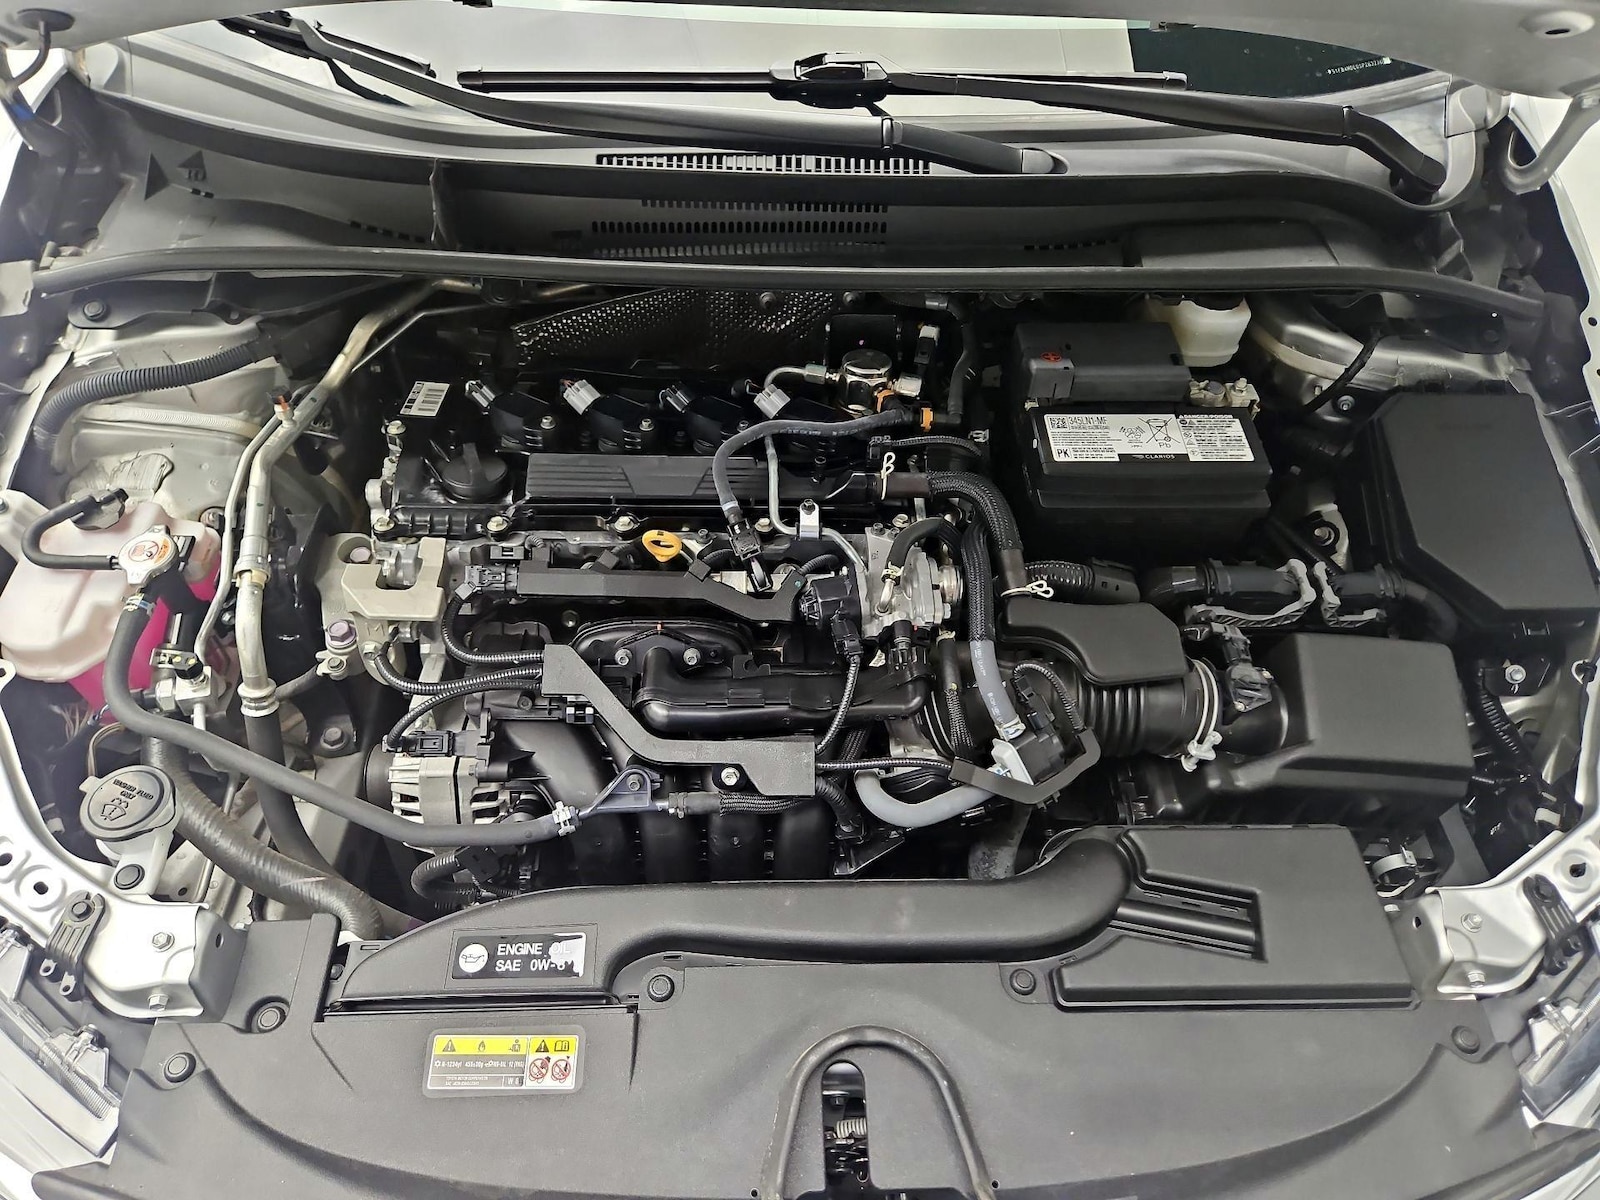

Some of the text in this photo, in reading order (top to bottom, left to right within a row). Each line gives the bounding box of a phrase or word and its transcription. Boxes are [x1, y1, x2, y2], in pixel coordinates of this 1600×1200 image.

[1057, 448, 1070, 458] PK
[497, 942, 571, 956] ENGINE OIL
[495, 959, 521, 972] SAE
